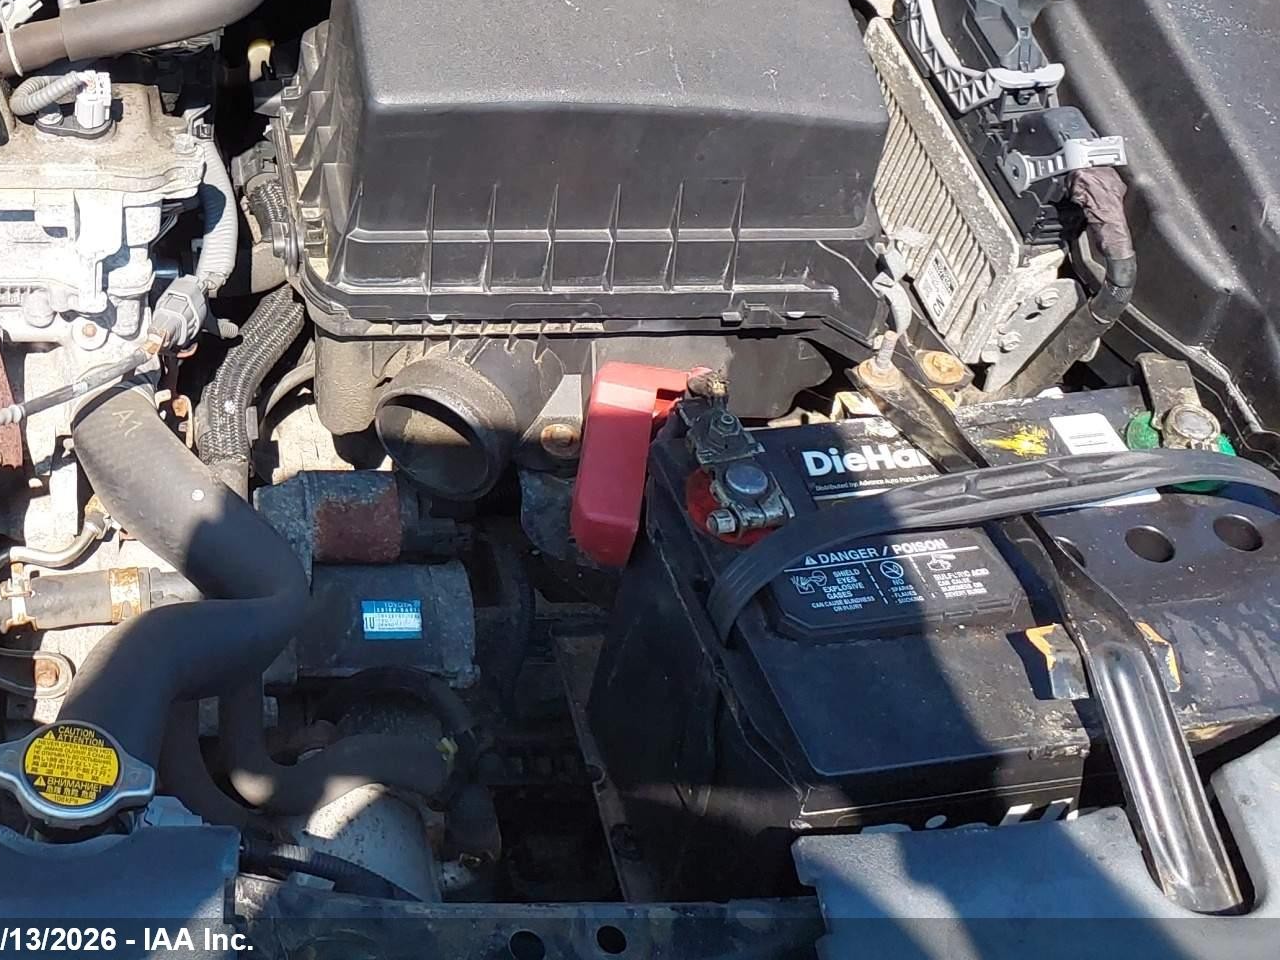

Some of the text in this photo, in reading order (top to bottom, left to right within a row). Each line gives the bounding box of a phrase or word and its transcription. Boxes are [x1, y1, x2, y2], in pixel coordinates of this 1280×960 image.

[818, 547, 880, 563] DANGER
[892, 538, 948, 555] POISON
[832, 568, 861, 578] SHIELD
[836, 575, 858, 584] EYES
[822, 581, 865, 593] EXPLOSIVE
[826, 590, 853, 600] GASES
[58, 726, 95, 738] CAUTION
[57, 733, 104, 747] ATTENTION
